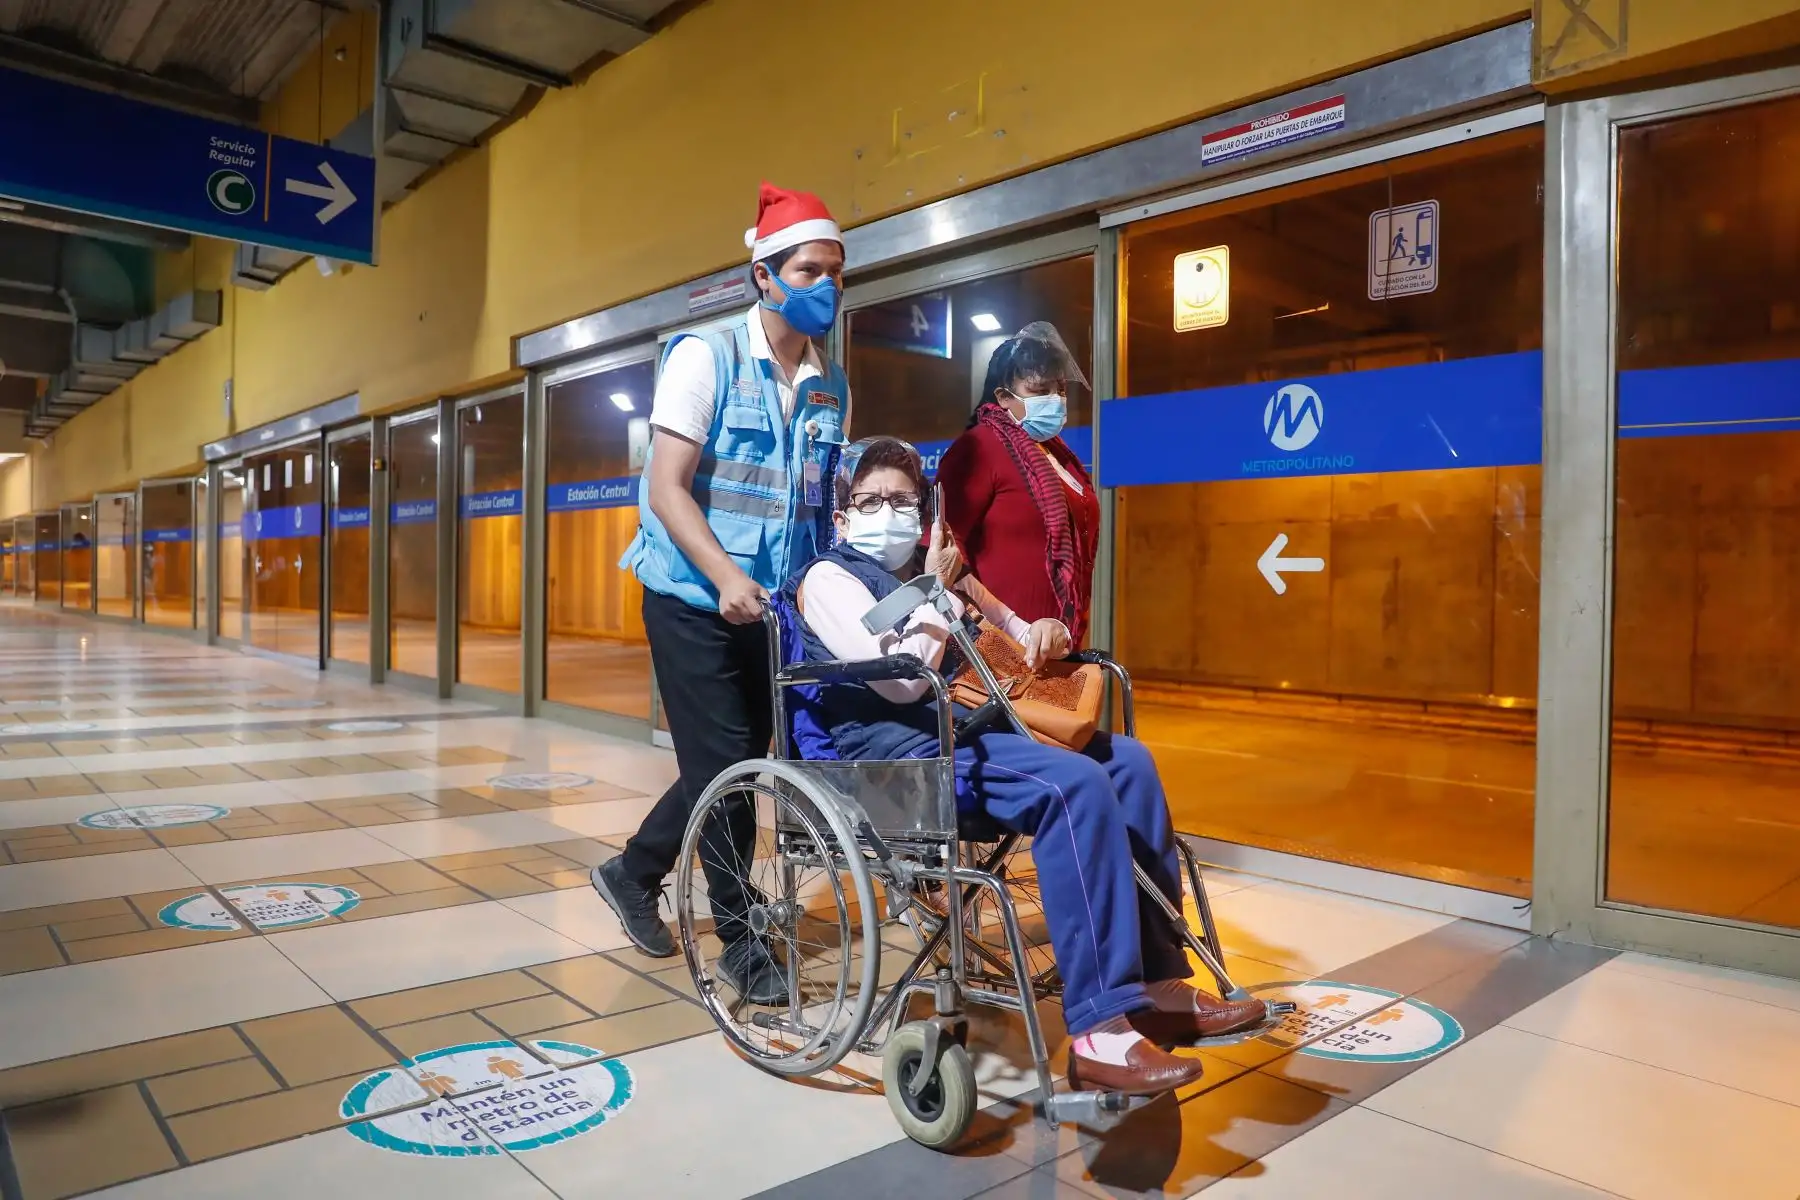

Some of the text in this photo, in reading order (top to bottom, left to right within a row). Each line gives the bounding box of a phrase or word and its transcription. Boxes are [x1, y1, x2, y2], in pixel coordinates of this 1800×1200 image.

[1250, 112, 1290, 130] PROHIBIDO
[1203, 109, 1343, 156] MANIPULAR O FORZAR LAS PUERTAS DE EMBARQUE
[210, 136, 256, 155] Servicio
[209, 149, 256, 168] Regular
[216, 176, 246, 210] C
[1378, 276, 1404, 286] CUDADO
[1242, 455, 1354, 473] METROPOLITANO
[568, 481, 630, 501] Estación Central
[1340, 1032, 1370, 1045] de
[1361, 1029, 1393, 1041] un
[539, 1077, 577, 1091] un
[447, 1089, 579, 1131] metro de
[460, 1100, 595, 1142] dstancia
